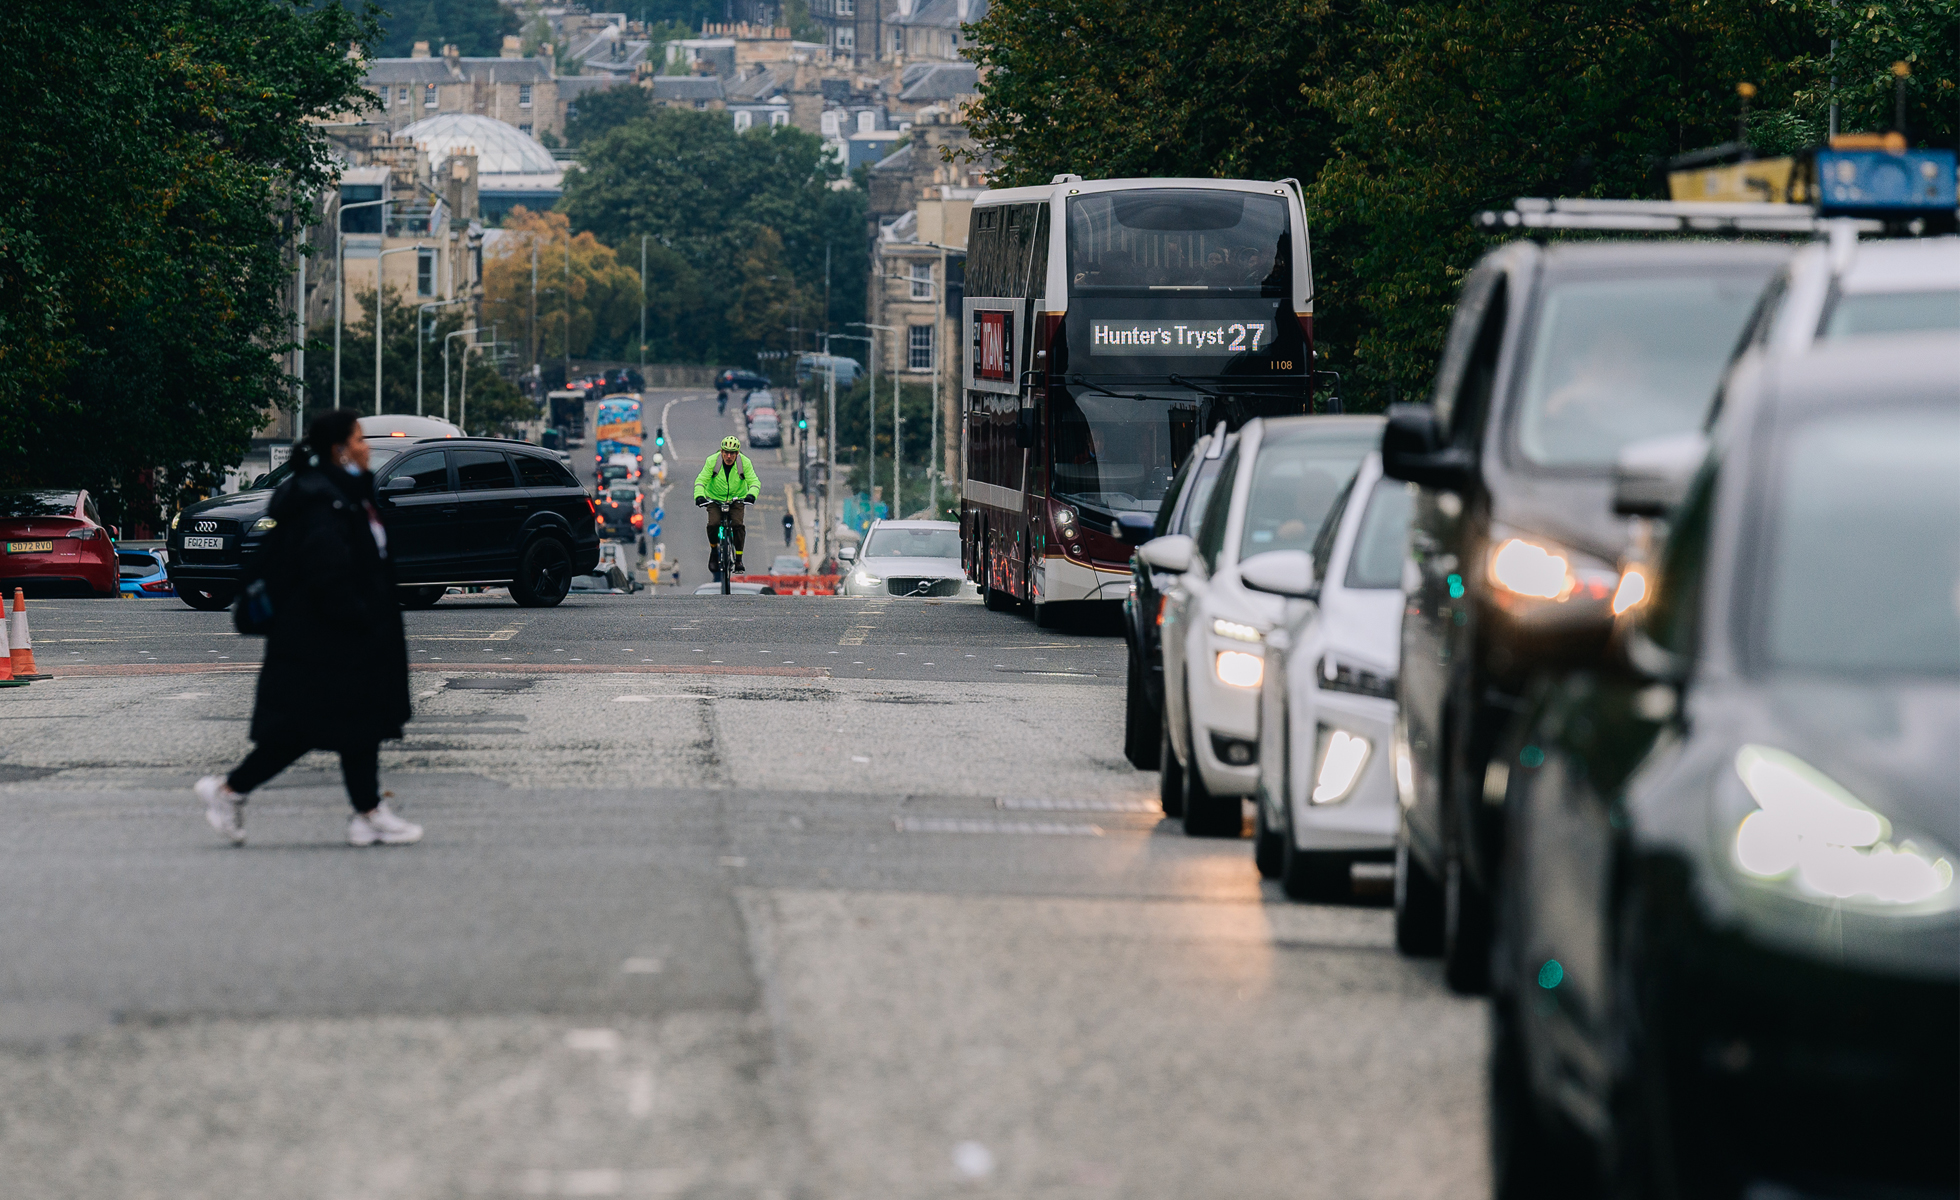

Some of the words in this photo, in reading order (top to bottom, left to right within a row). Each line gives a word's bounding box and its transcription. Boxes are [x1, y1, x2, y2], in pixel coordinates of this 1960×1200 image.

[1094, 325, 1172, 345] Hunter's
[1174, 325, 1225, 349] Tryst
[1228, 323, 1265, 351] 27
[1270, 360, 1293, 370] 1108
[12, 542, 34, 551] SD72
[203, 538, 218, 548] FEX
